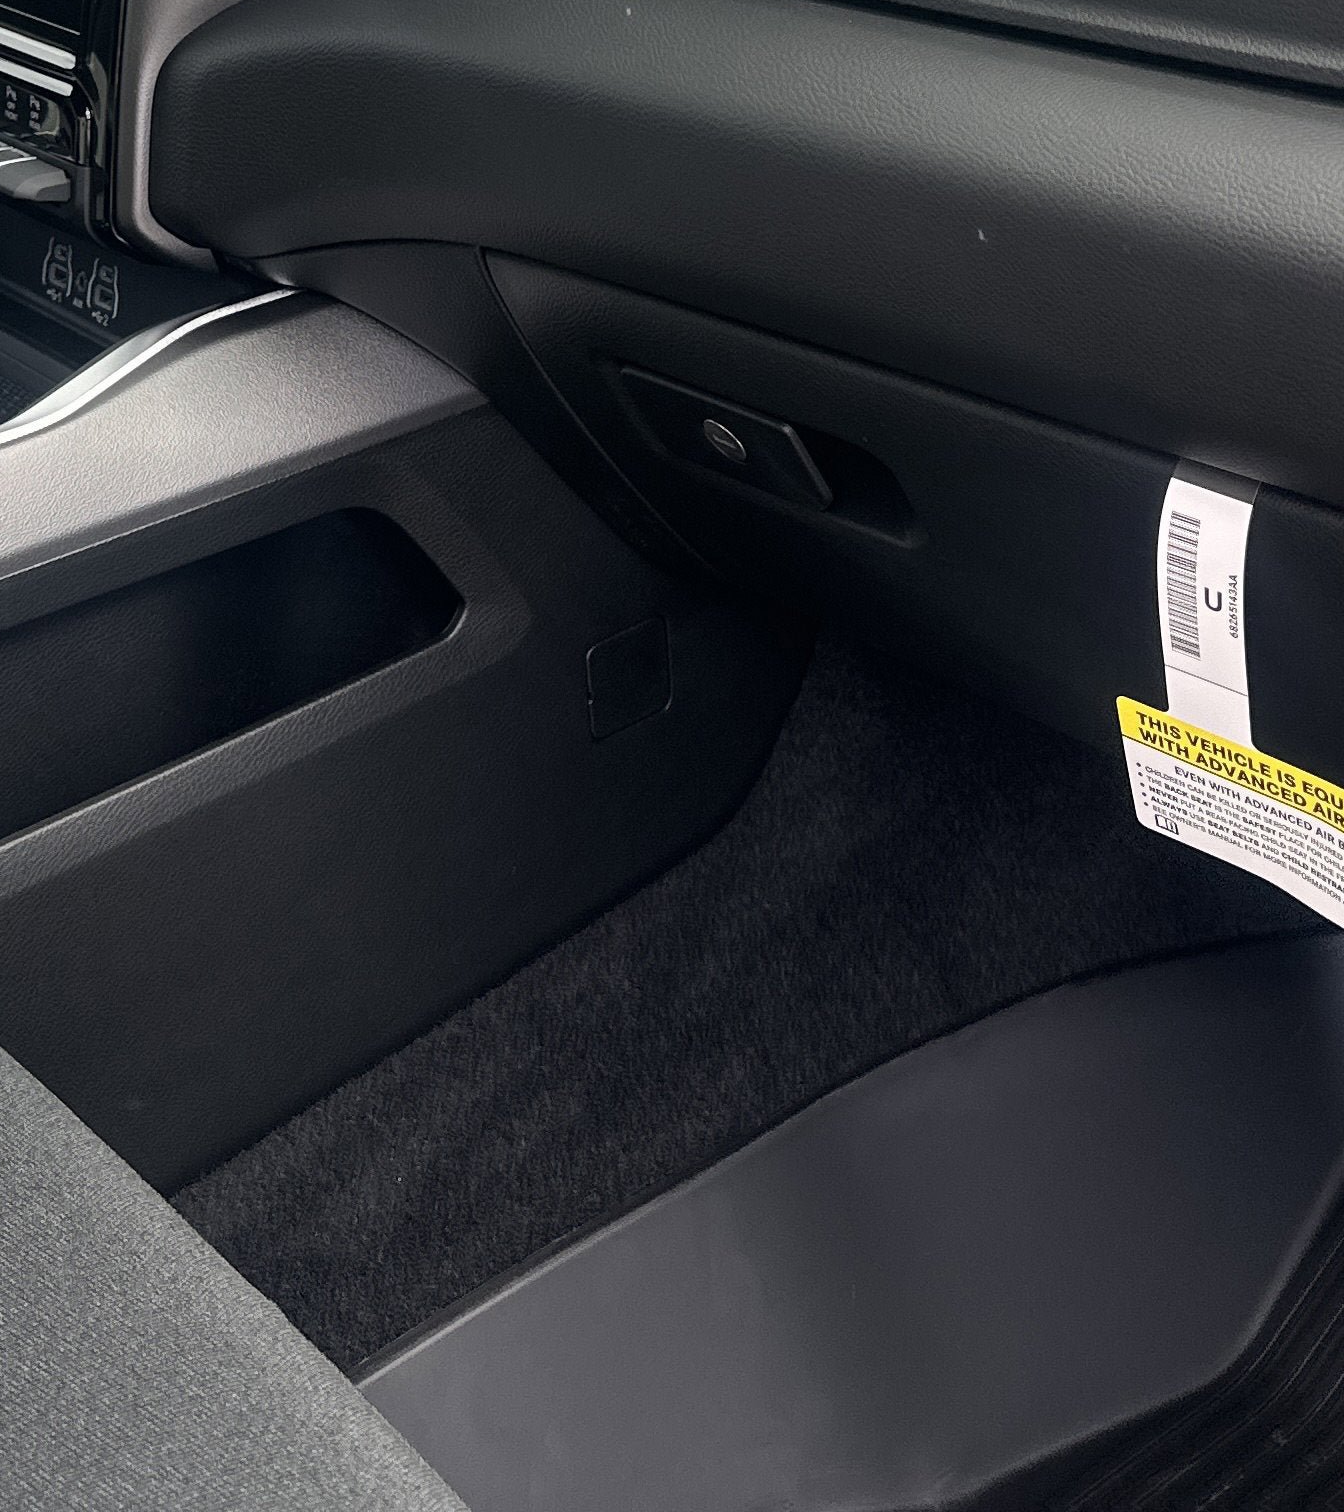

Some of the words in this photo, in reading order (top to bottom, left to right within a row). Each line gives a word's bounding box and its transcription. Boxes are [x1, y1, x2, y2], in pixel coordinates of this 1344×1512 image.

[1204, 587, 1222, 612] U
[1228, 574, 1239, 639] 68265143AA
[1136, 710, 1181, 739] THIS
[1185, 731, 1272, 778] VEHICLE
[1277, 769, 1296, 787] IS
[1139, 727, 1189, 759] WITH
[1196, 752, 1307, 806] ADVANCED
[1145, 766, 1185, 788] CHILDREN
[1149, 785, 1178, 803] NEVER
[1261, 833, 1286, 849] CHILD
[1151, 796, 1188, 816] ALWAYS
[1208, 820, 1230, 833] SEAT
[1232, 830, 1259, 847] BELTS
[1281, 852, 1309, 870] CHILD
[1164, 782, 1189, 799] BACK
[1279, 832, 1305, 849] PLACE
[1307, 845, 1322, 859] FOR
[1175, 765, 1205, 786] EVEN
[1209, 780, 1241, 801] WITH
[1245, 796, 1313, 831] ADVANCED
[1316, 827, 1336, 845] AIR
